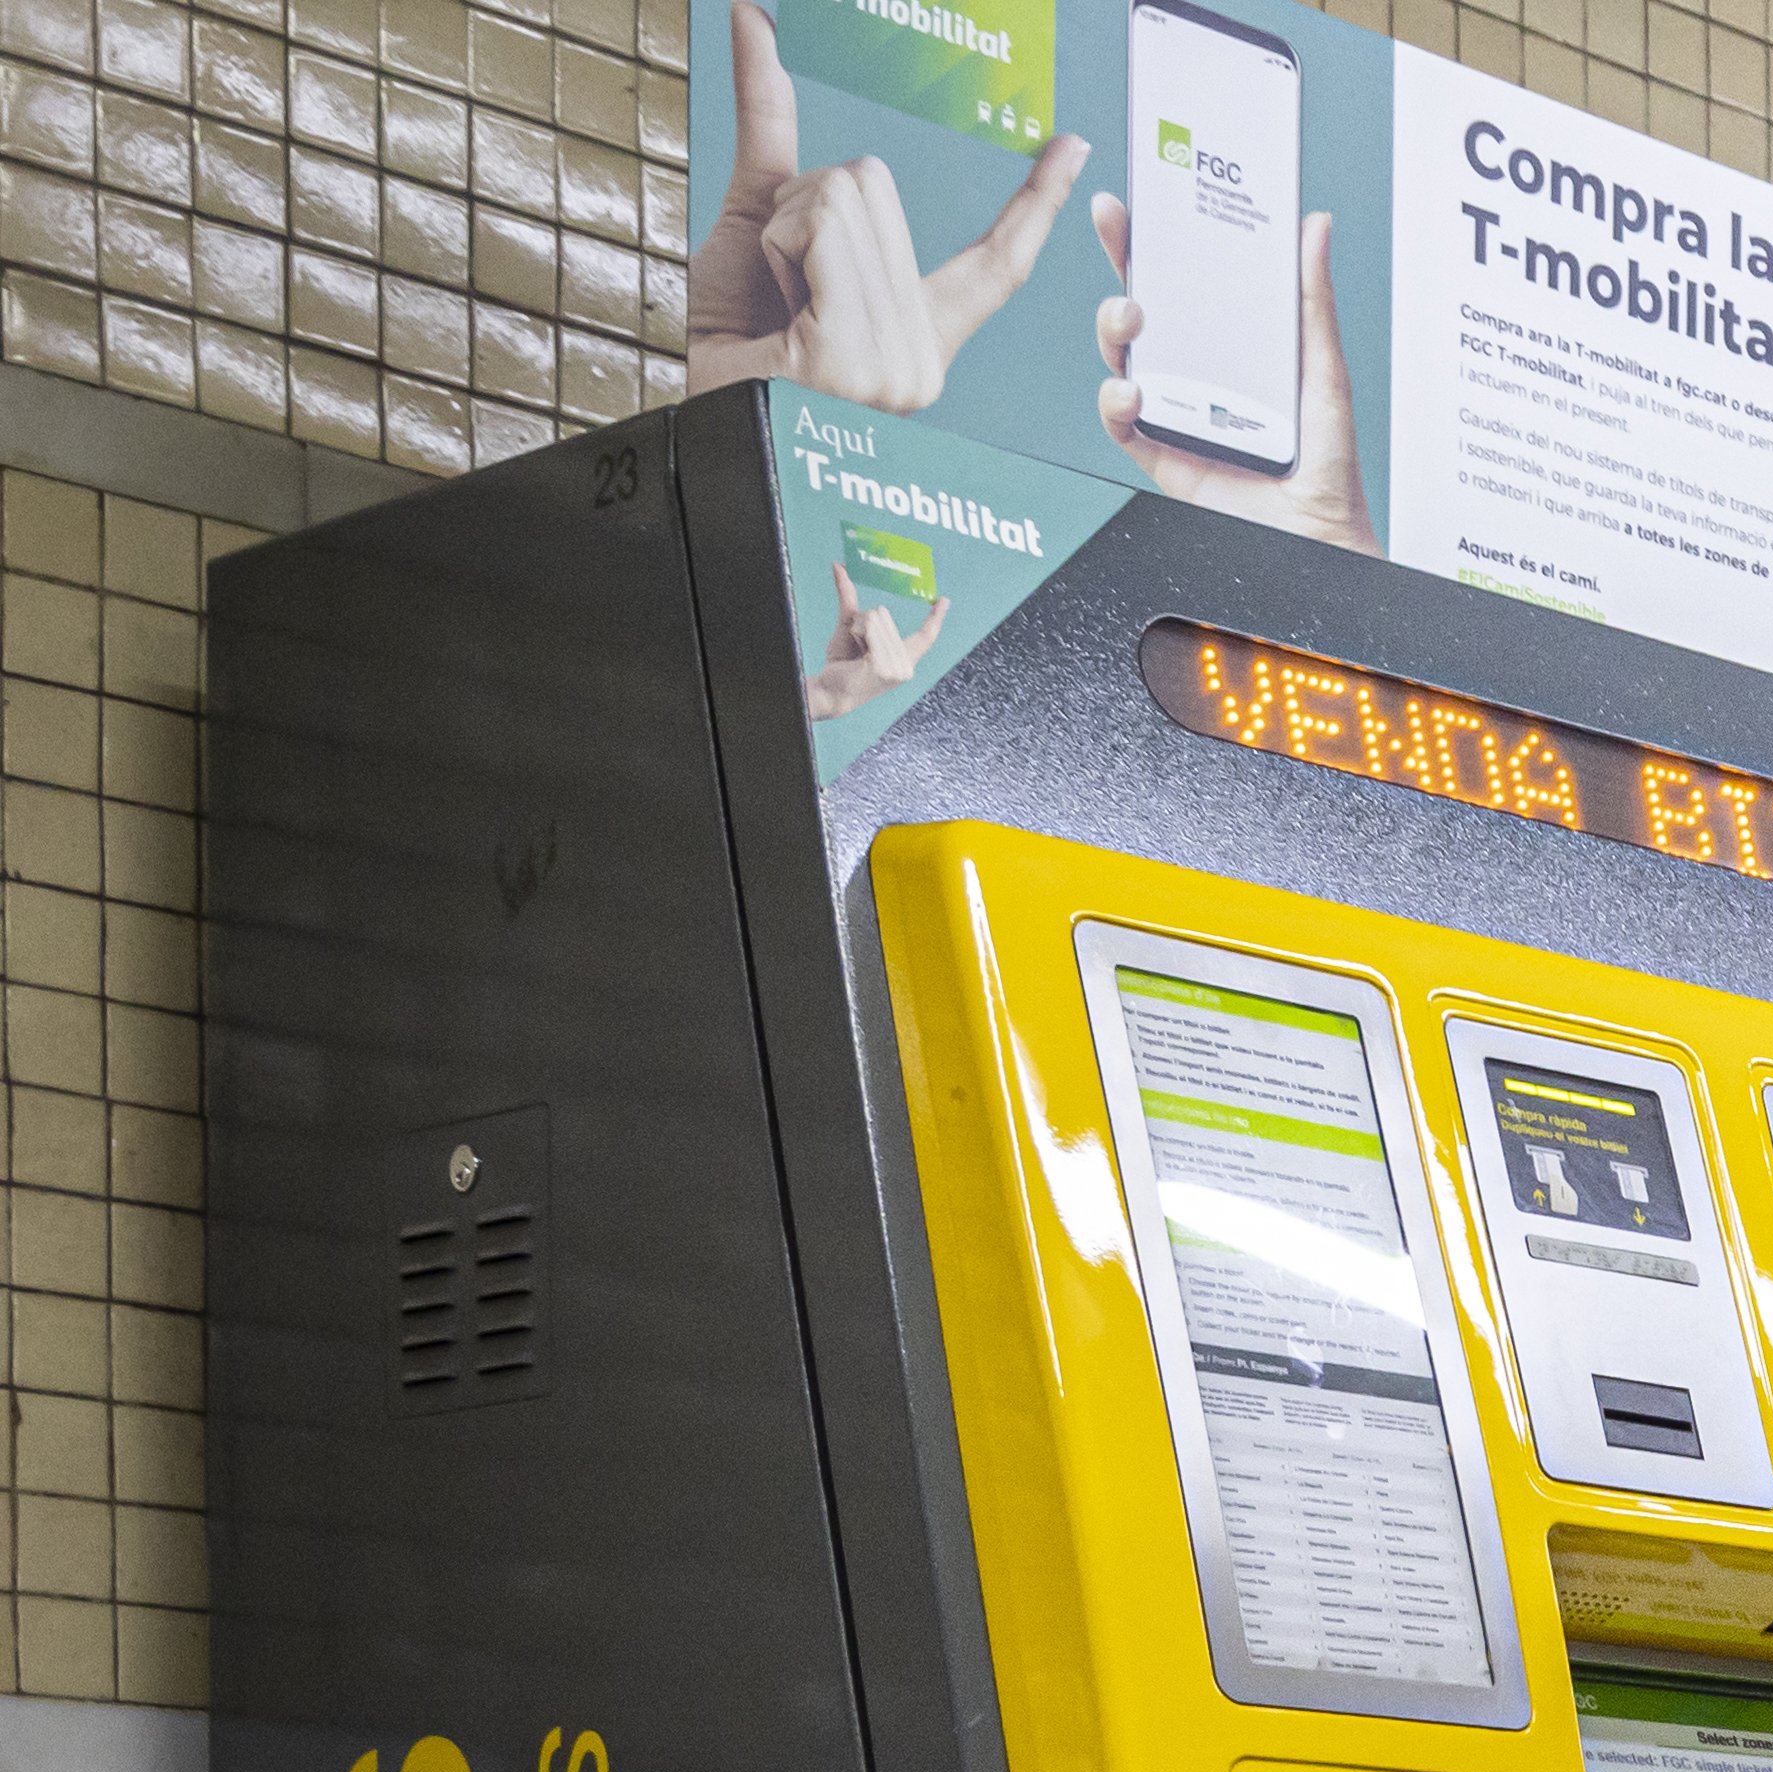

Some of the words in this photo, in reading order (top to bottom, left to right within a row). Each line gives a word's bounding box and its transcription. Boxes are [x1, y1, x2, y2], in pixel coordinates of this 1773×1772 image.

[1196, 149, 1241, 185] FGC
[1464, 120, 1708, 259] Compra
[1461, 303, 1523, 337] Compra
[1528, 327, 1552, 348] ara
[1558, 334, 1570, 354] la
[1575, 341, 1659, 385] T-mobilitat
[1664, 374, 1672, 388] a
[1677, 377, 1728, 408] fgc.cat
[1732, 398, 1741, 412] o
[1461, 332, 1492, 357] FGC
[1600, 382, 1631, 405] puja
[1635, 393, 1648, 411] al
[1651, 397, 1681, 421] tren
[1685, 410, 1714, 433] dels
[1718, 422, 1744, 442] que
[1468, 367, 1527, 399] actuem
[1531, 388, 1551, 406] en
[1554, 395, 1568, 412] el
[794, 405, 877, 458] Aquí
[1459, 408, 1522, 441] Gaudeix
[1526, 429, 1549, 449] del
[1554, 440, 1583, 461] nou
[1587, 450, 1644, 481] sistema
[1648, 470, 1665, 488] de
[1708, 488, 1726, 508] de
[794, 446, 1043, 557] T-mobilitat
[1467, 441, 1548, 482] sostenible,
[1552, 468, 1581, 489] que
[1585, 479, 1637, 507] guarda
[1641, 495, 1653, 513] la
[1657, 501, 1688, 524] teva
[1458, 536, 1515, 567] Aquest
[1519, 555, 1537, 573] és
[1541, 563, 1555, 579] el
[1559, 570, 1602, 593] camí.
[1459, 470, 1468, 485] o
[1473, 473, 1533, 505] robatori
[1544, 497, 1573, 517] que
[1577, 507, 1621, 532] arriba
[1624, 521, 1633, 536] a
[1637, 524, 1675, 549] totes
[1679, 536, 1701, 557] les
[1704, 548, 1747, 572] zones
[1751, 560, 1769, 579] de
[1203, 646, 1577, 826] VENDA
[1497, 1101, 1546, 1124] Compra
[1599, 1752, 1661, 1768] selected:
[1663, 1755, 1691, 1769] FGC
[1697, 1730, 1739, 1748] Select
